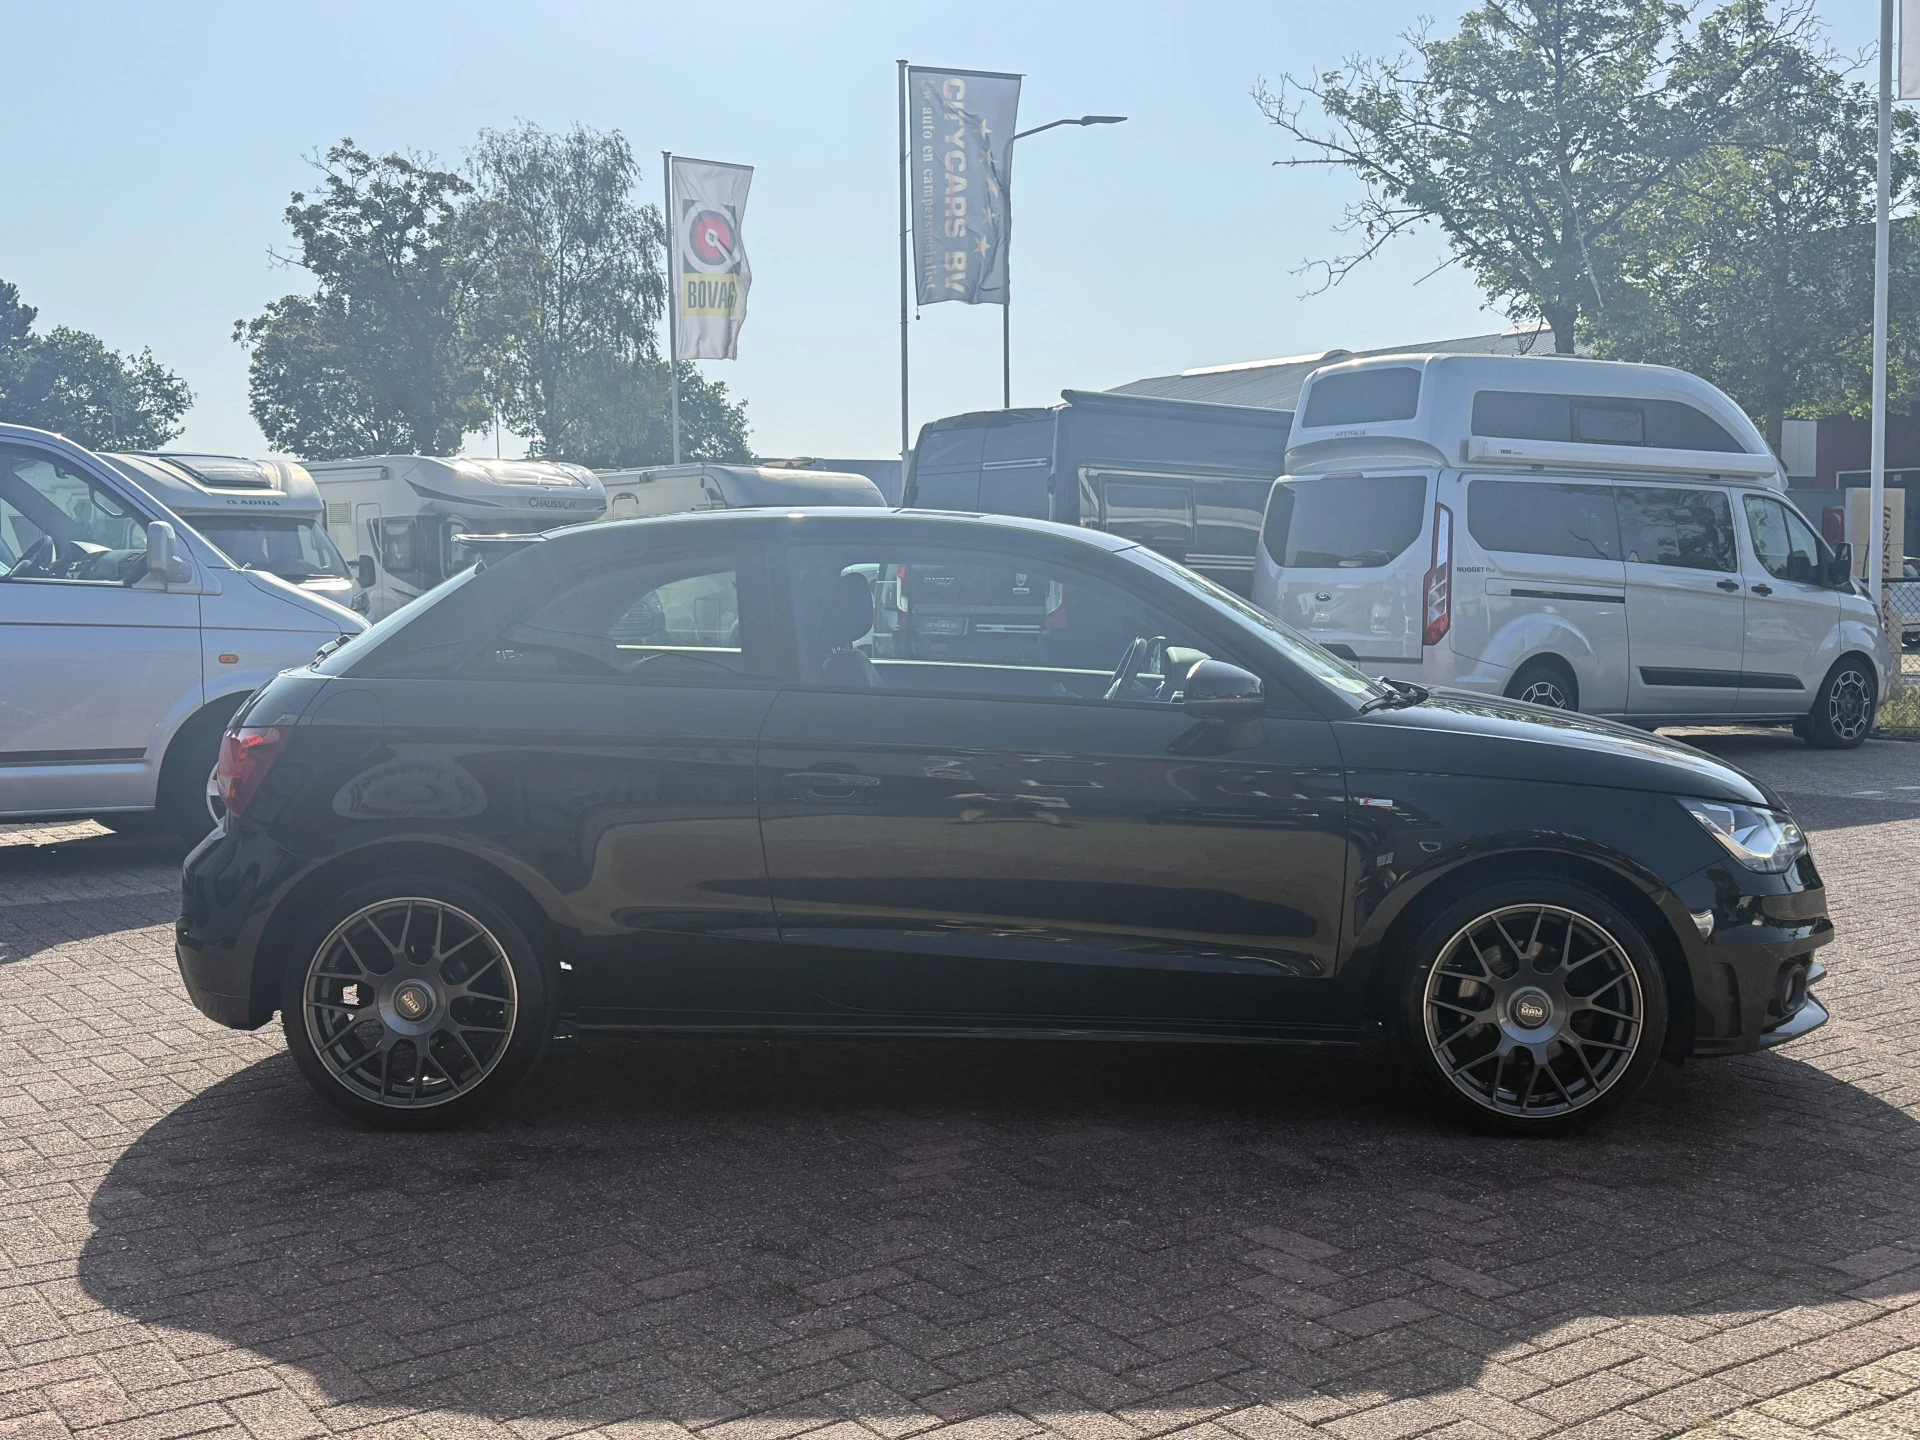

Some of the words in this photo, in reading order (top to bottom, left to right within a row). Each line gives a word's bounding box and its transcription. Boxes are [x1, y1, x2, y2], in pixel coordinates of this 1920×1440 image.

[922, 107, 935, 139] auto
[923, 145, 933, 162] en
[943, 78, 967, 238] CITYCARS
[944, 251, 967, 293] BV
